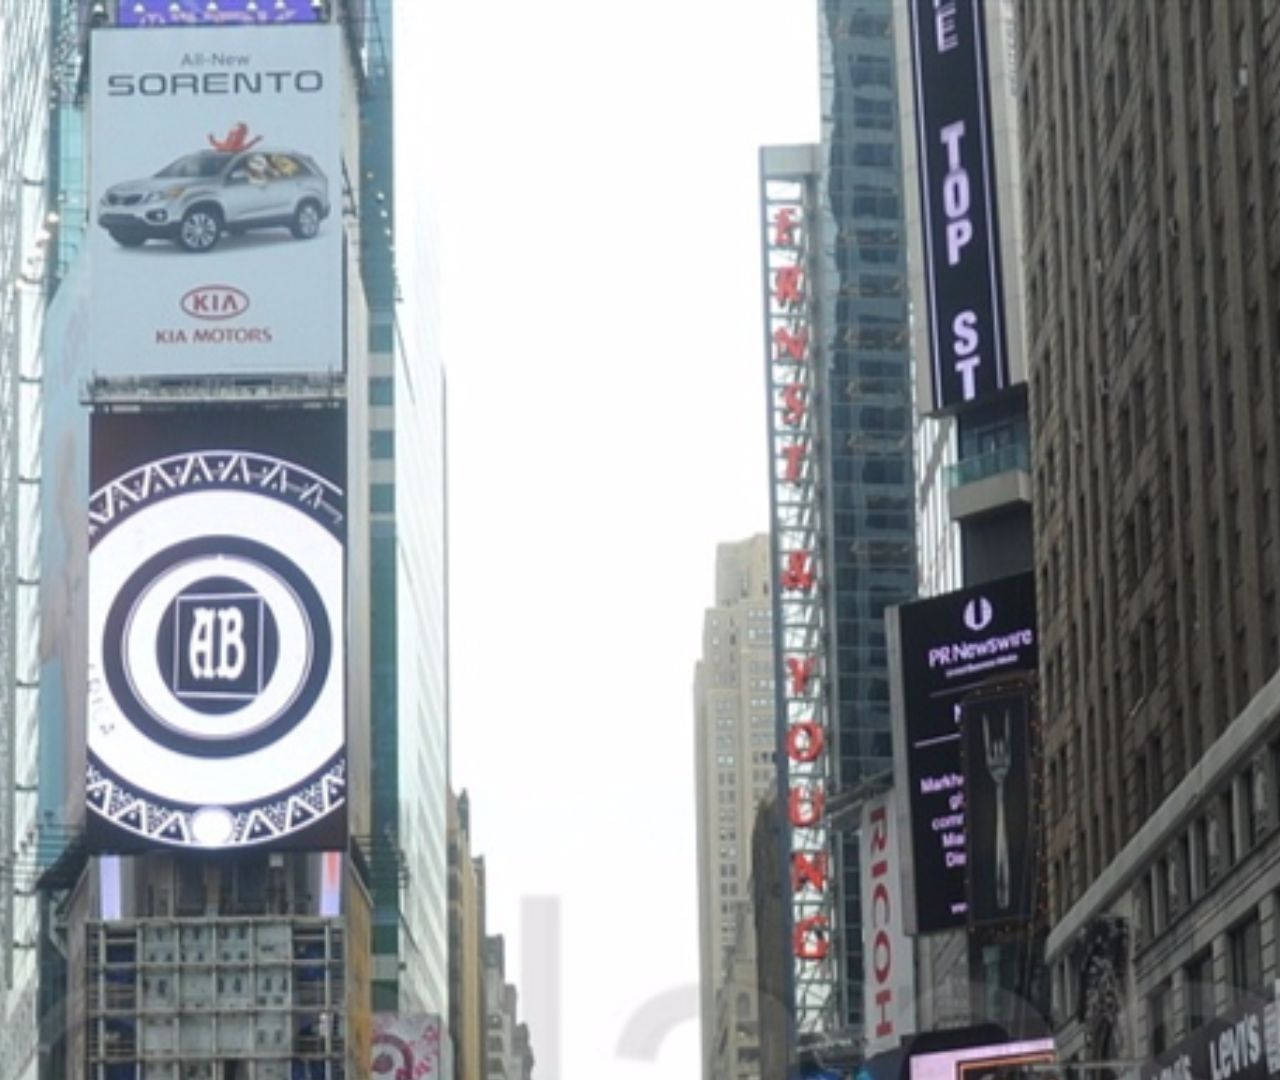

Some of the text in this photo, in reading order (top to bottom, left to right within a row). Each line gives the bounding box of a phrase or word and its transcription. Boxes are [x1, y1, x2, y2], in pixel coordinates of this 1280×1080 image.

[108, 69, 324, 97] SORENTO
[180, 53, 251, 67] All-New
[939, 120, 972, 266] TOP
[155, 327, 272, 345] KIA MOTORS
[191, 293, 239, 313] KIA
[772, 206, 808, 487] ERNST
[787, 658, 828, 959] YOUNG
[870, 806, 892, 1038] RICOH
